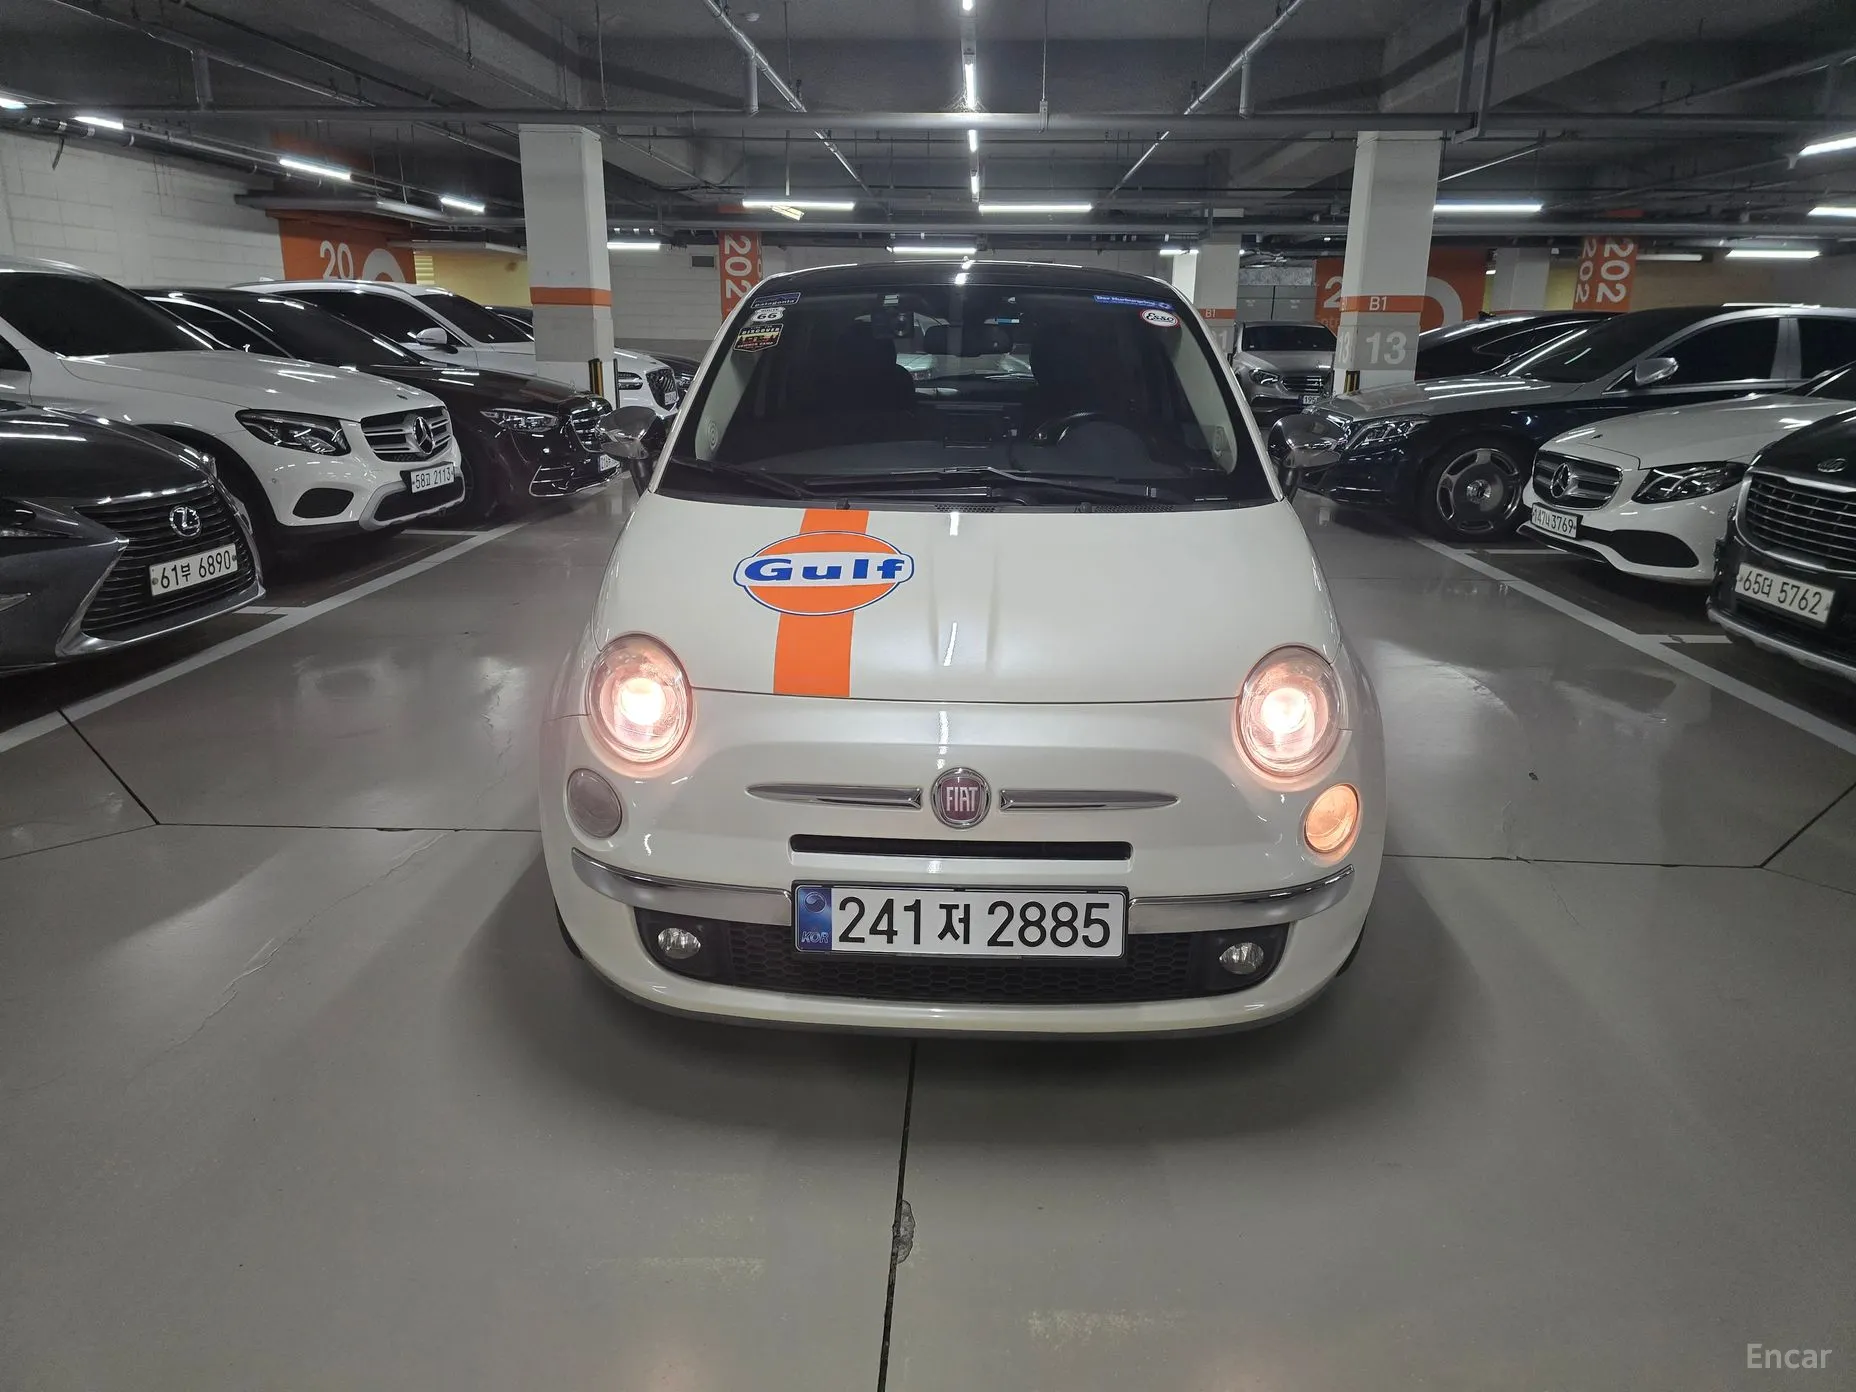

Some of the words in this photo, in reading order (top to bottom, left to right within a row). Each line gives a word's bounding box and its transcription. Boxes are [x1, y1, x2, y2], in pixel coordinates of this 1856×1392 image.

[320, 240, 354, 280] 20
[1596, 236, 1635, 303] 202
[1205, 309, 1216, 318] B1
[1369, 296, 1387, 311] B1
[757, 312, 778, 320] 66
[1146, 312, 1174, 323] Esso
[1366, 331, 1408, 365] 13
[433, 467, 451, 485] 2113
[1551, 514, 1574, 533] 3769
[160, 563, 191, 589] 61부
[199, 550, 231, 578] 6890
[744, 558, 905, 582] Gulf
[1743, 570, 1773, 598] 65더
[1777, 581, 1822, 616] 5762
[946, 786, 978, 812] FIAT
[987, 900, 1111, 948] 2885
[801, 930, 830, 945] KOR
